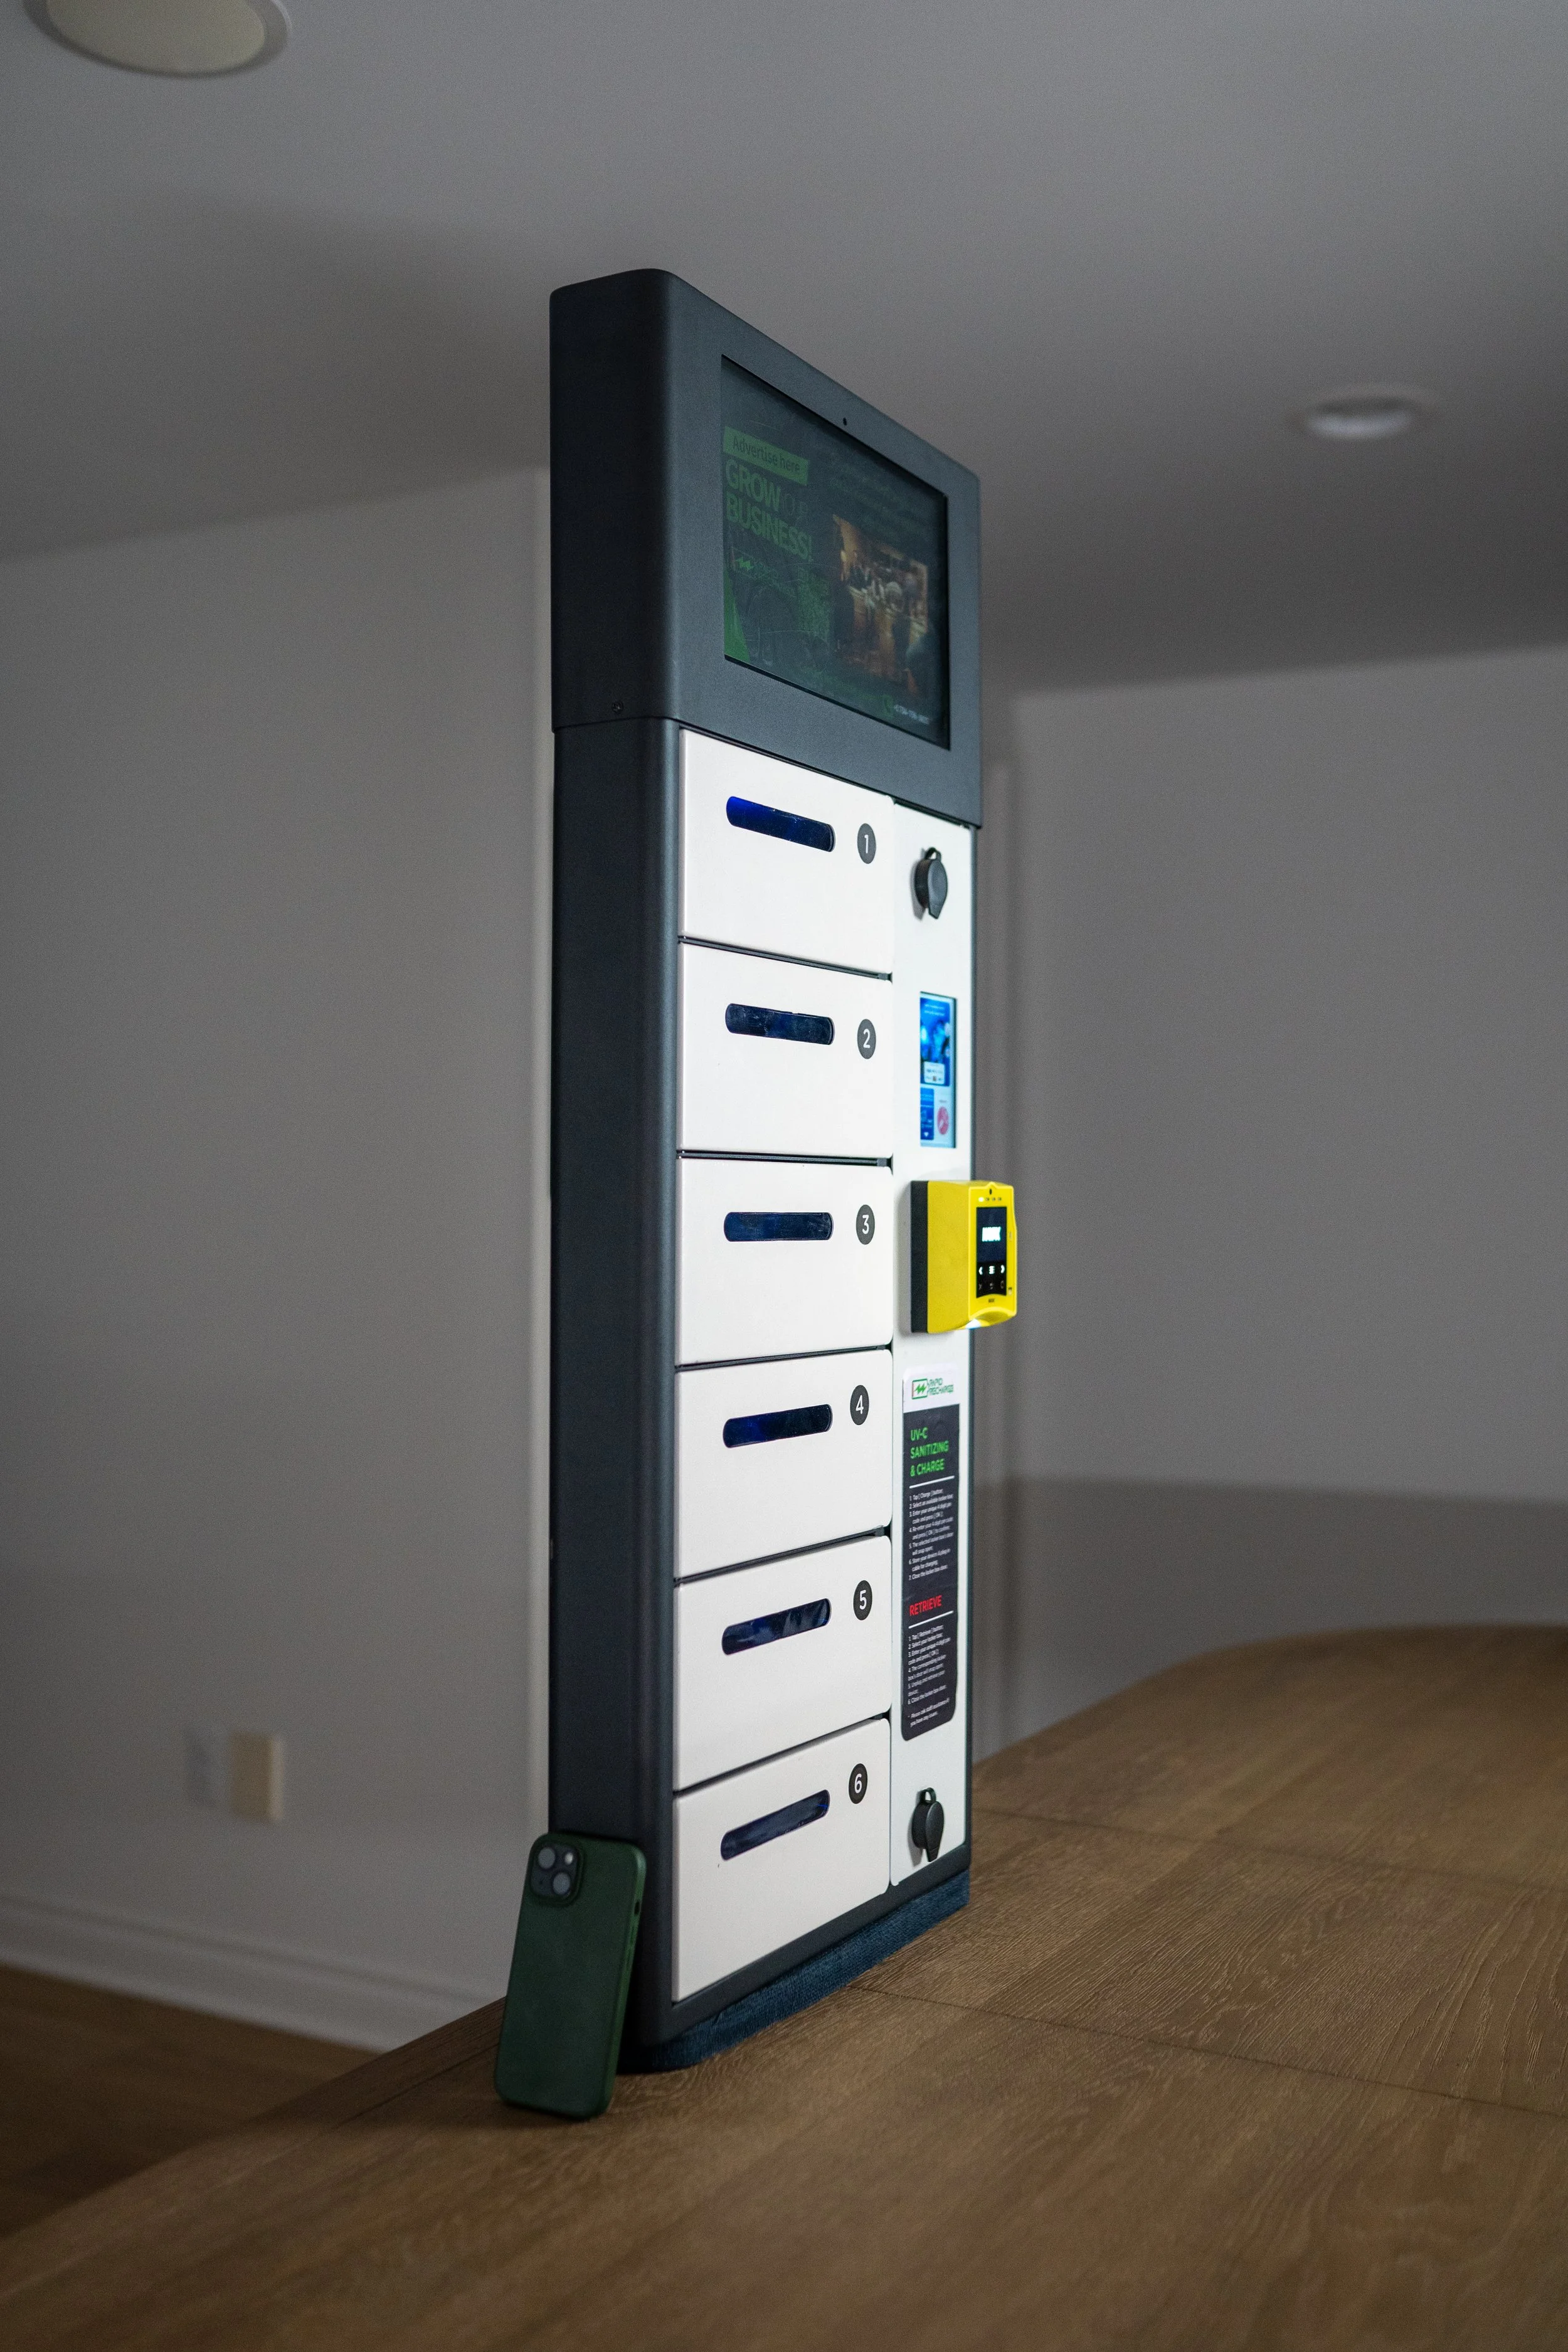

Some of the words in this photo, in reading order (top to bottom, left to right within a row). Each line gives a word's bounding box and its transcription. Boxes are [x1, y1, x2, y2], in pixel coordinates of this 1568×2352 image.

[733, 436, 778, 465] Advertise
[780, 453, 801, 472] here
[726, 458, 781, 512] GROW
[726, 490, 813, 563] BUSINESS!
[864, 834, 869, 854] 1
[863, 1028, 871, 1049] 2
[862, 1214, 869, 1234] 3
[856, 1394, 864, 1414] 4
[911, 1427, 928, 1441] UV-C
[910, 1440, 949, 1459] SANITIZING
[916, 1458, 944, 1475] CHARGE
[859, 1589, 867, 1610] 5
[909, 1595, 943, 1616] RETRIEVE
[854, 1773, 862, 1794] 6
